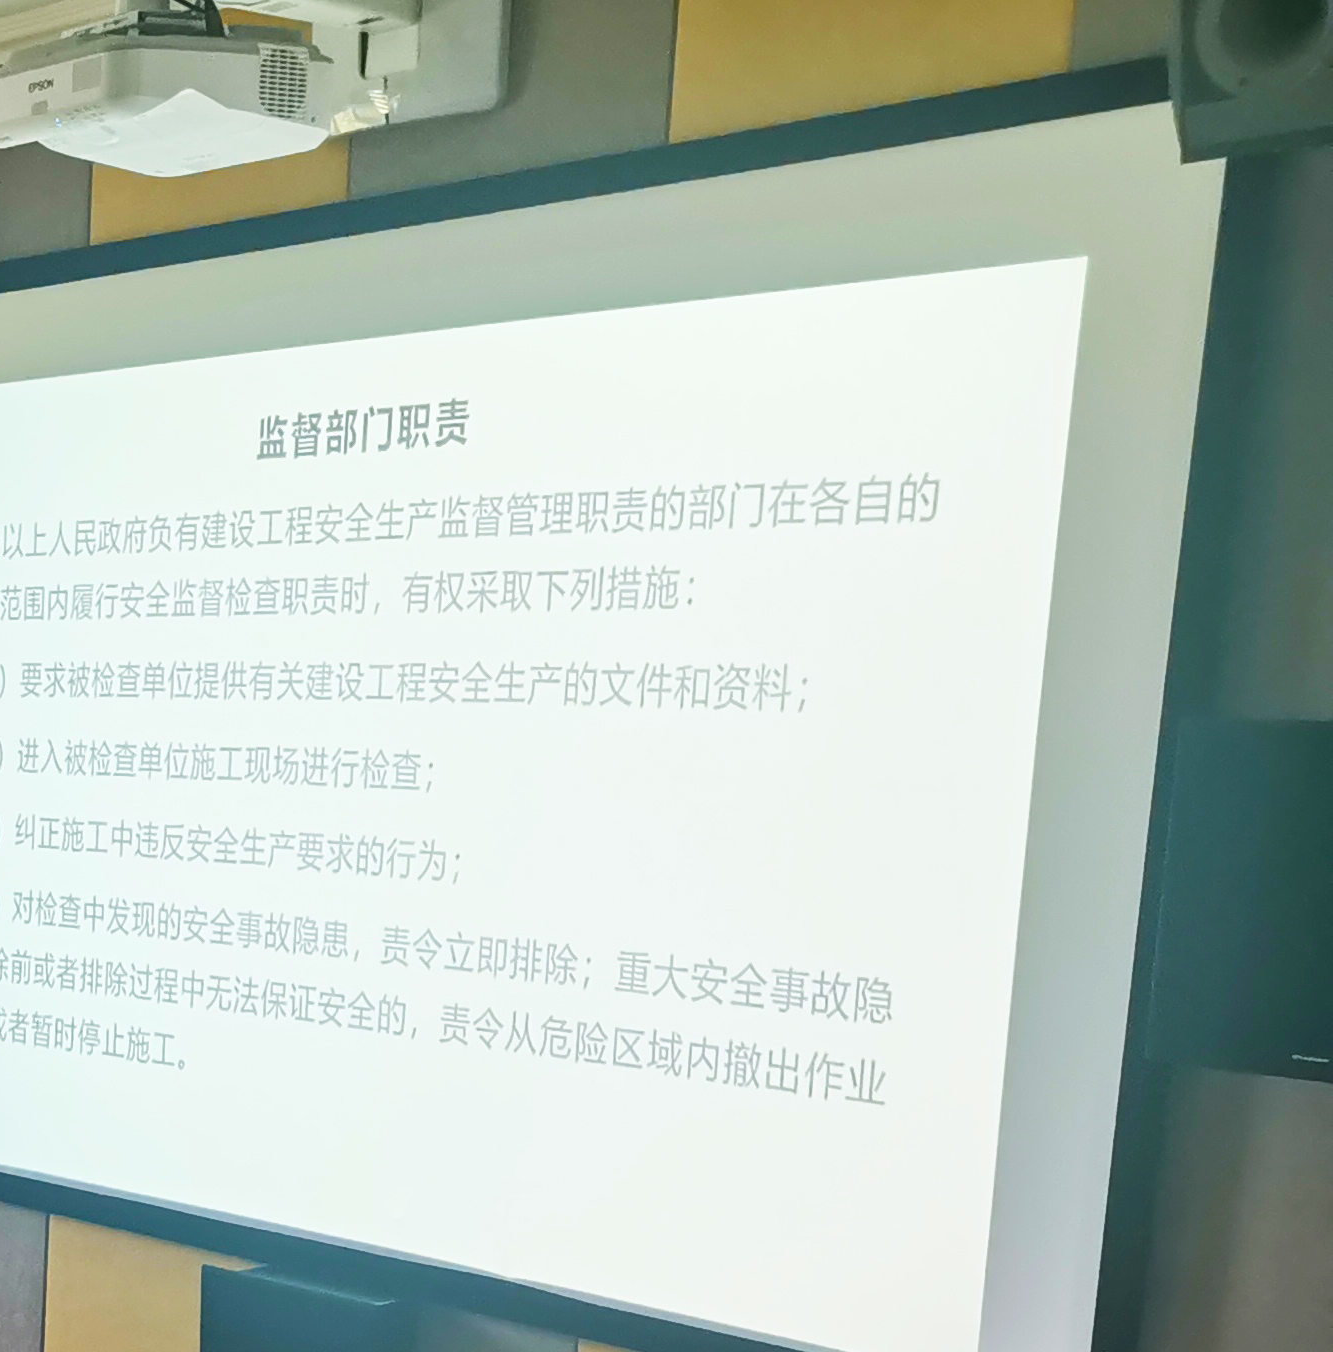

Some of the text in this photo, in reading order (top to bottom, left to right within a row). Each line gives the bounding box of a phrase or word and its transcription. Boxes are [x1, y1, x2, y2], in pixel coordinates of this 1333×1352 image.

[28, 78, 54, 94] EPSON
[257, 398, 470, 460] 监督部门职责
